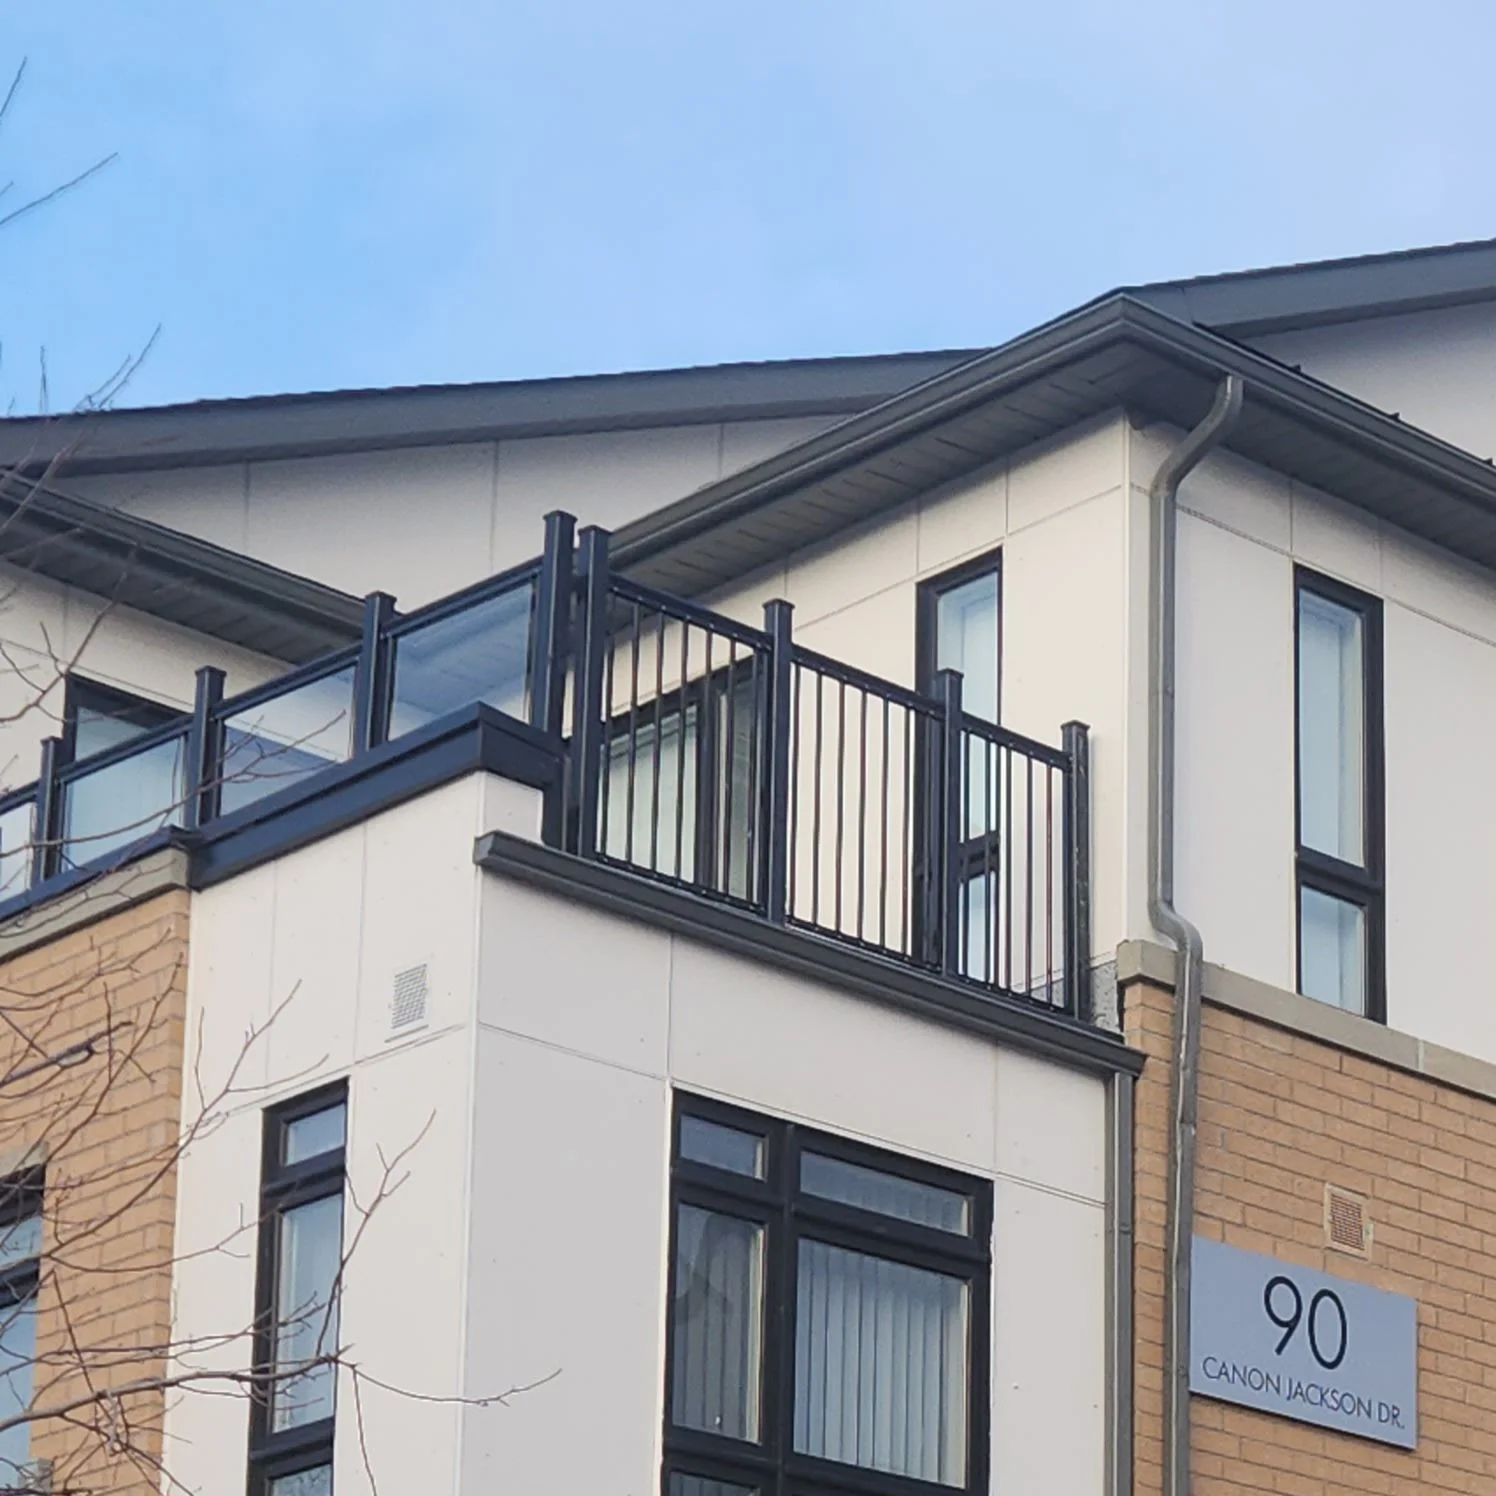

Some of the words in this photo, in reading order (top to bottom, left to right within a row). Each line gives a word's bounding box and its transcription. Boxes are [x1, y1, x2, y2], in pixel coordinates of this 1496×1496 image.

[1263, 1276, 1347, 1370] 90
[1202, 1356, 1281, 1396] CANON
[1287, 1377, 1372, 1420] JACKSON
[1378, 1402, 1405, 1429] DR.
